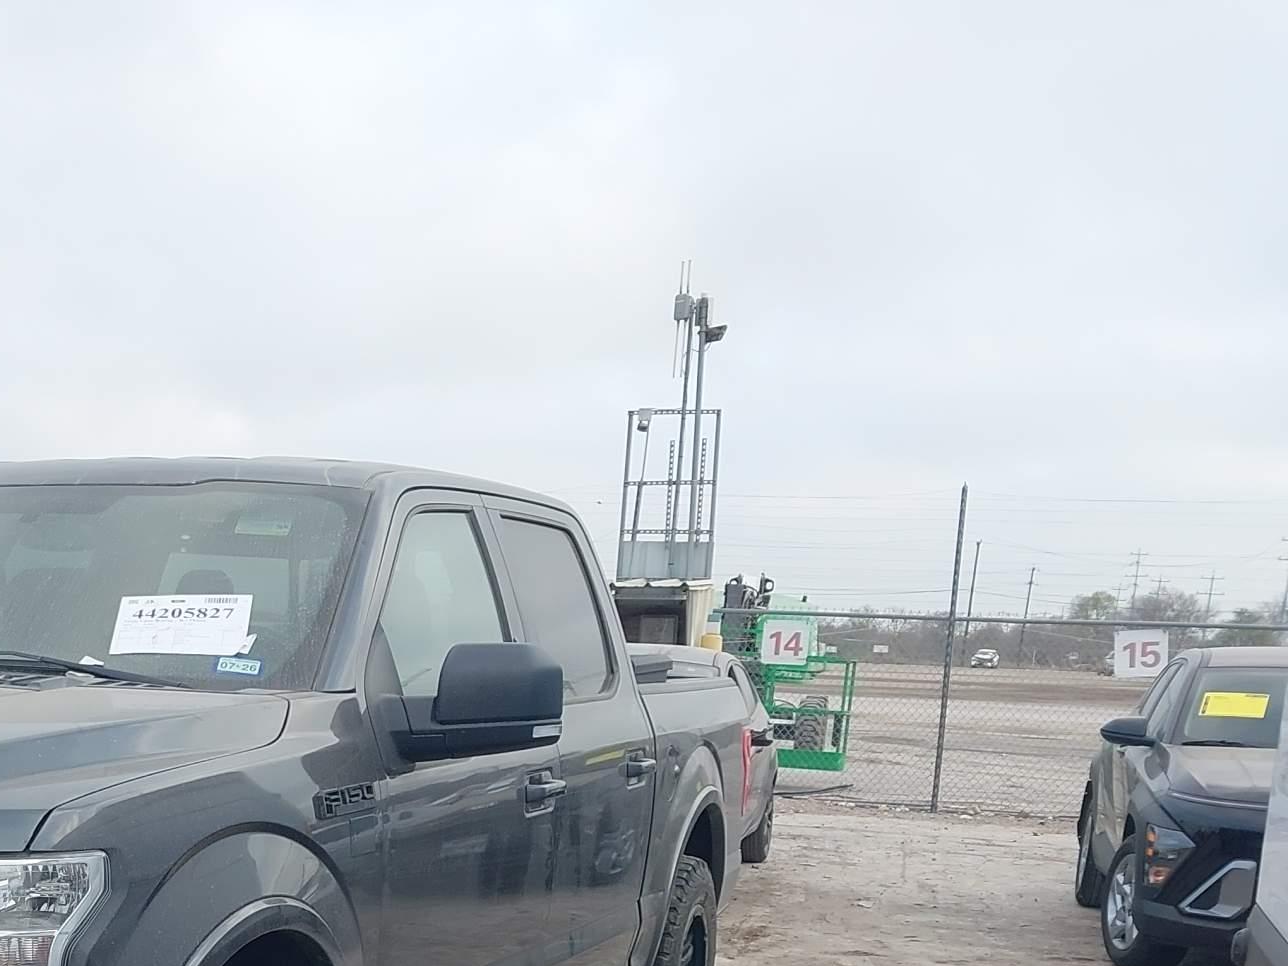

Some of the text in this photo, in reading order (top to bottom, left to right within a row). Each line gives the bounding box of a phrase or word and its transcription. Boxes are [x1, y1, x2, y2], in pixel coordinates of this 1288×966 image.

[132, 607, 235, 619] 44205827
[769, 631, 804, 657] 14
[1122, 641, 1161, 668] 15
